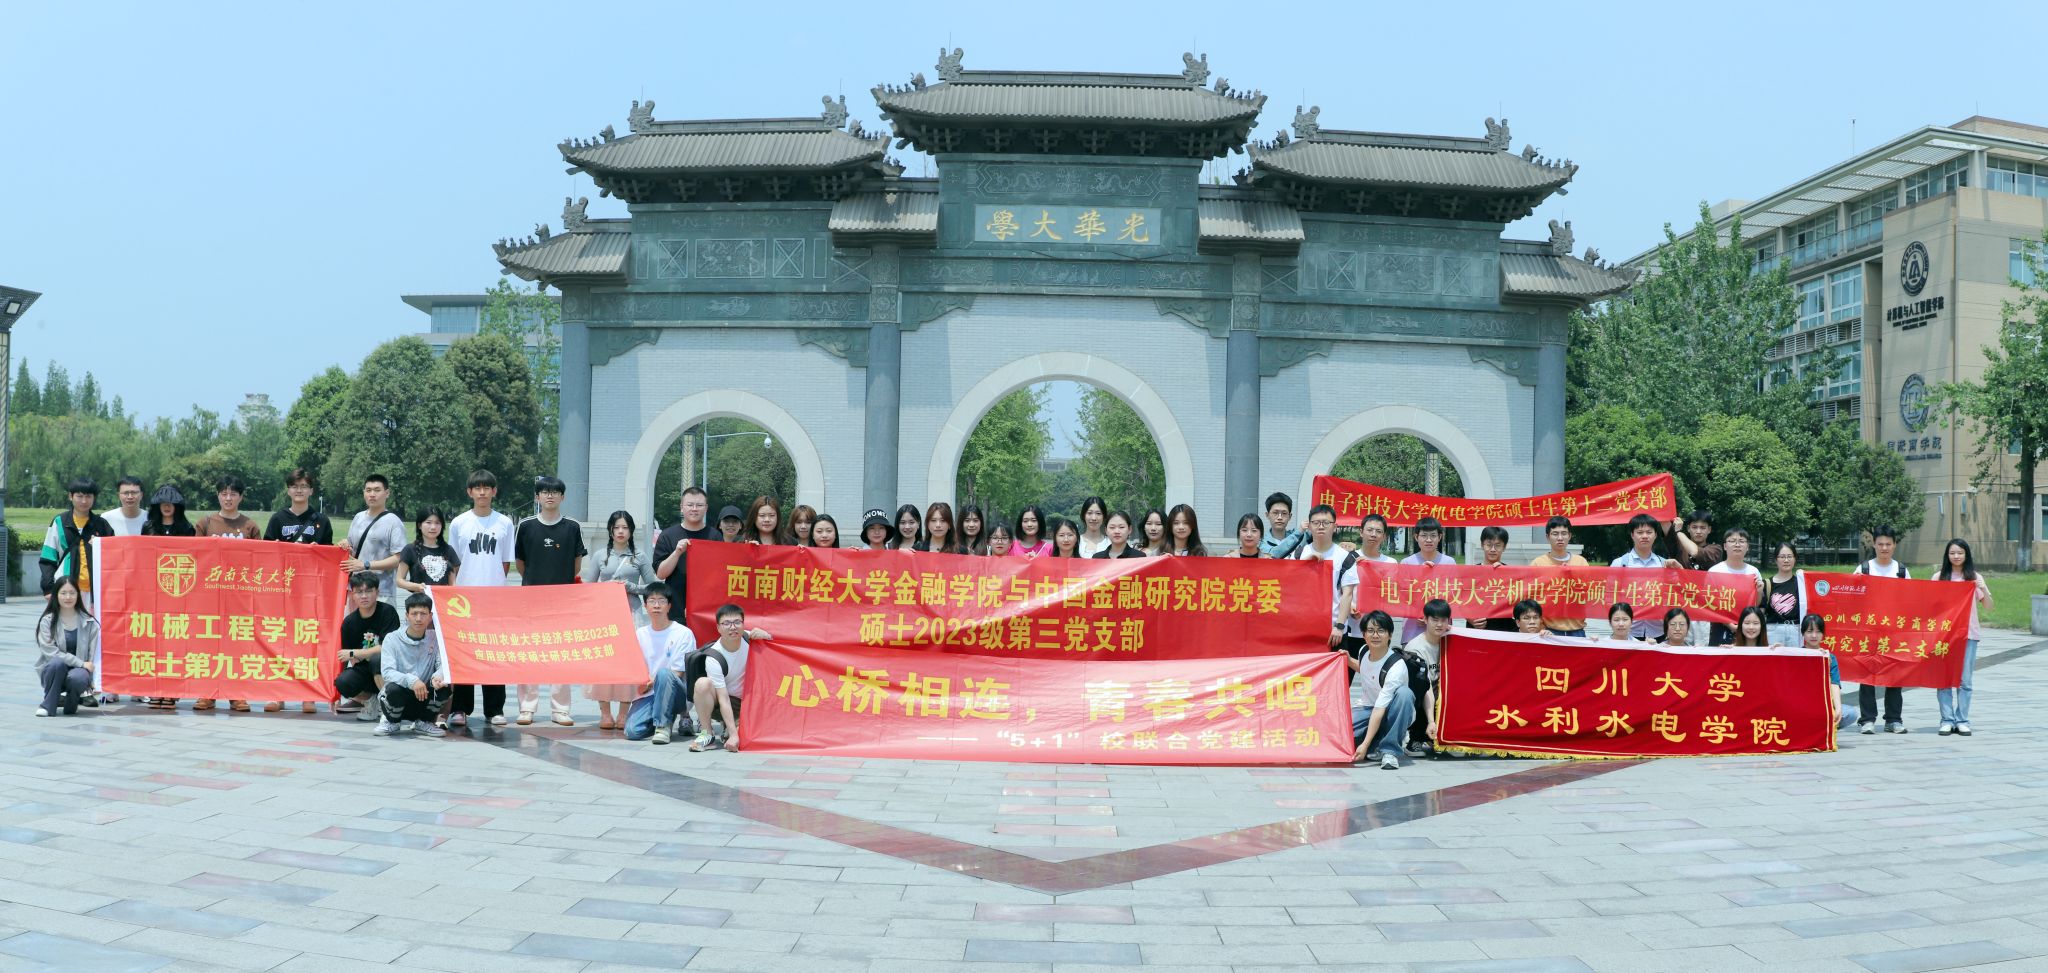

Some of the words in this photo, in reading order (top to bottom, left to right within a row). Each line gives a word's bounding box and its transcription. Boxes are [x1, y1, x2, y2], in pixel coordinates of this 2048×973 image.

[1320, 486, 1668, 522] 电子科技大学机电学院硕士生第十二党支部
[726, 565, 1282, 614] 西南财经大学金融学院与中国金融研究院党委
[1381, 577, 1737, 612] 电子科技大学机电学院硕士生第五党支部
[130, 612, 320, 645] 机械工程学院
[457, 624, 620, 646] 中共四川农业大学经济学院2023级
[860, 613, 1145, 653] 硕士2023级第三党支部
[1823, 613, 1952, 632] 四川师范大学商学院
[475, 644, 615, 664] 应用经济学硕士研究生党支部
[1821, 635, 1950, 658] 研究生第二支部
[130, 651, 320, 682] 硕士第九党支部
[1536, 666, 1745, 702] 四川大学
[1485, 704, 1790, 746] 水利水电学院
